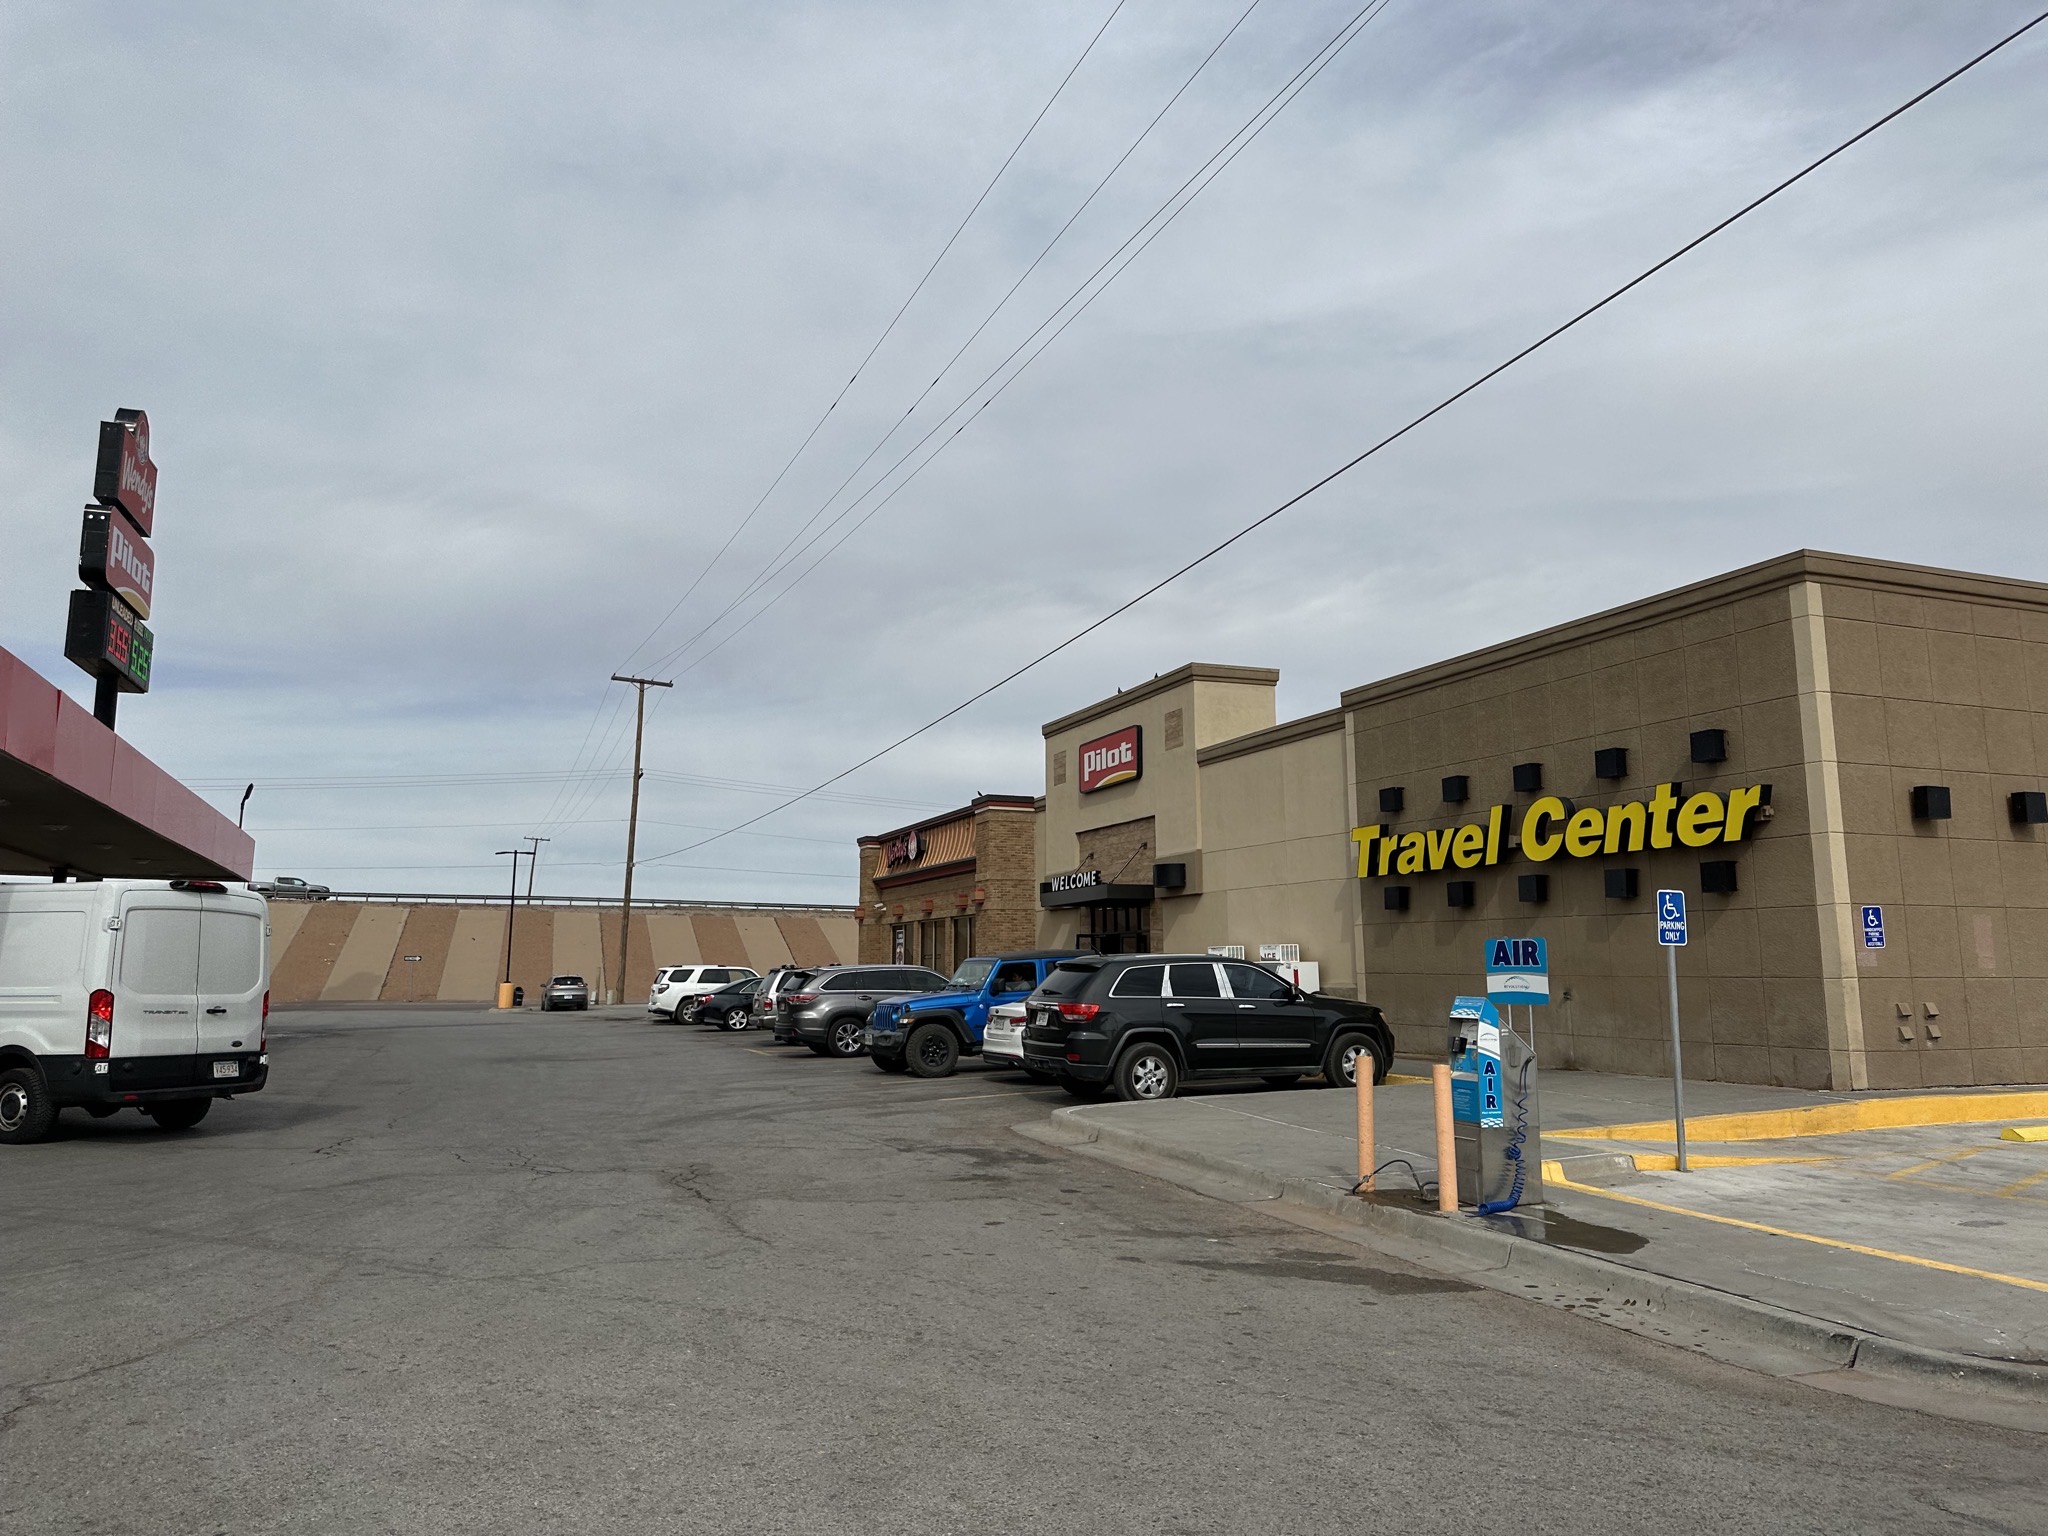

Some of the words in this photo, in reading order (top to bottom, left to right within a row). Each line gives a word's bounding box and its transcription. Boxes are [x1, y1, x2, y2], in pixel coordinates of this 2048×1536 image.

[122, 451, 153, 514] Wendy's
[110, 526, 151, 594] Pilot
[1083, 741, 1132, 782] Pilot
[1351, 805, 1504, 879] Travel
[1520, 782, 1762, 863] Center
[1051, 871, 1097, 892] WELCOME
[1660, 921, 1685, 931] PARKING
[1665, 931, 1680, 942] ONLY
[1492, 939, 1541, 967] AIR
[1483, 1060, 1498, 1109] AIR
